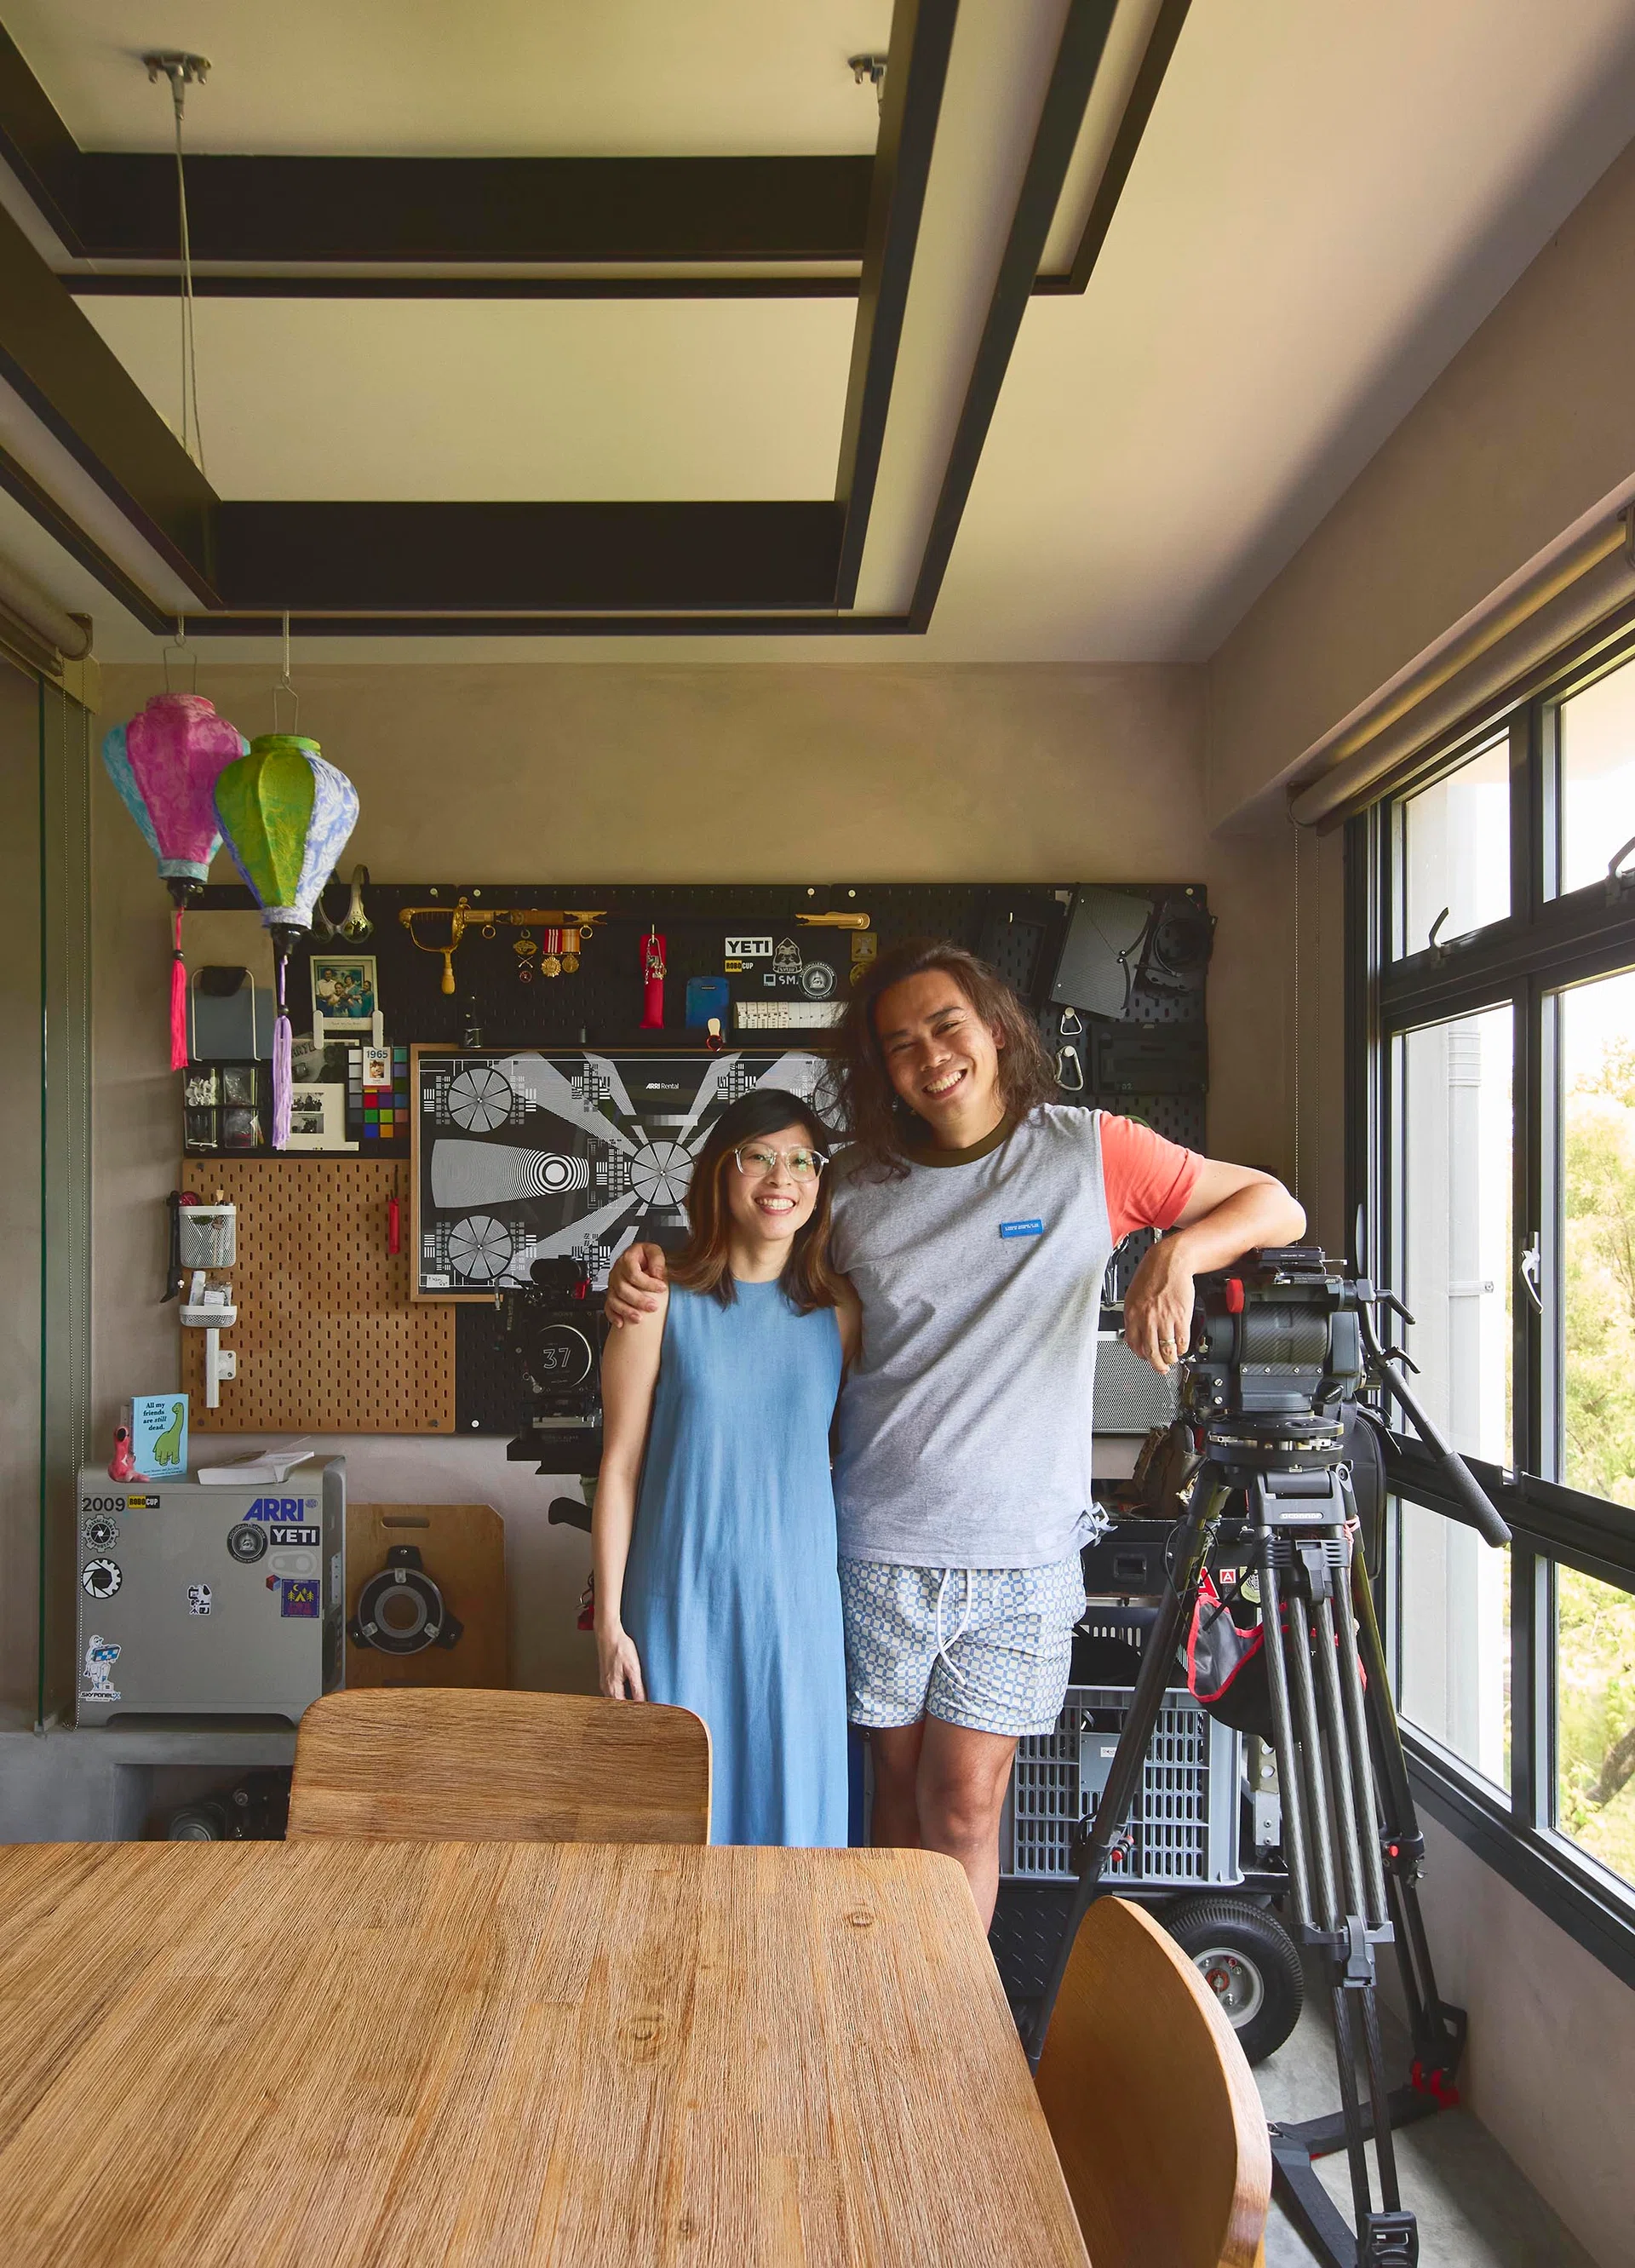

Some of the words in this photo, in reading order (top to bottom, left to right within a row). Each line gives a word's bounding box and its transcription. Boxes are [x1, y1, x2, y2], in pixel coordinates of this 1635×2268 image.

[727, 941, 769, 953] YETI
[367, 1050, 388, 1059] 1965
[542, 1347, 571, 1369] 37
[83, 1497, 125, 1512] 2009
[242, 1498, 304, 1521] ARRI
[272, 1529, 316, 1543] YETI
